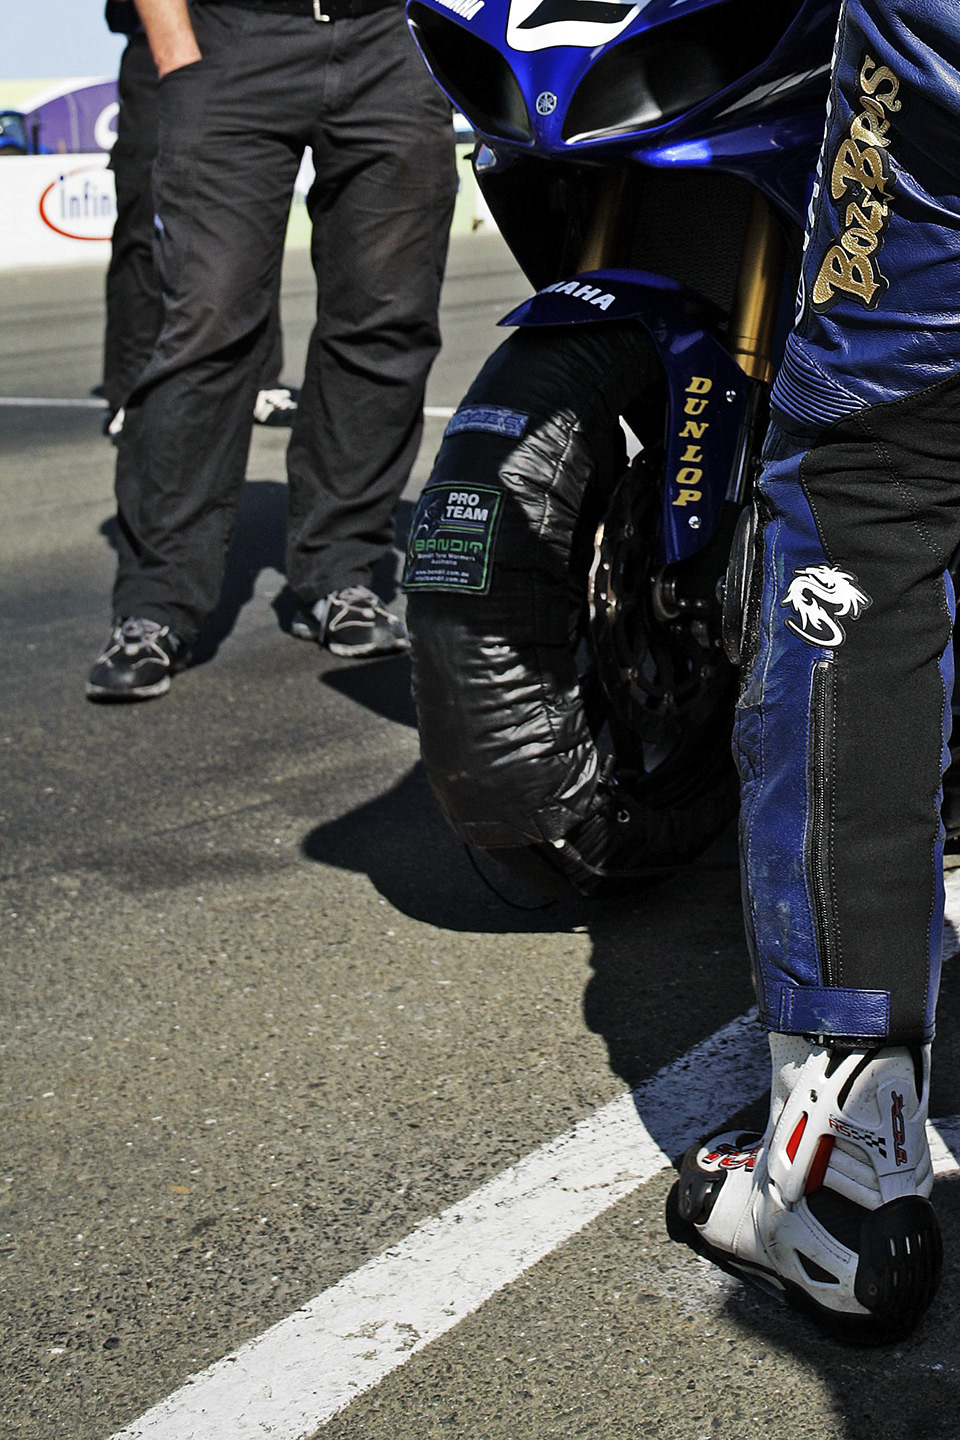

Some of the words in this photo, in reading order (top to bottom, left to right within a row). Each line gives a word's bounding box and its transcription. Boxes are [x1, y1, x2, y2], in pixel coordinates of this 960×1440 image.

[671, 376, 713, 507] DUNLOP
[447, 492, 480, 507] PRO
[446, 506, 489, 522] TEAM
[415, 538, 483, 554] BANDIT
[828, 1118, 851, 1137] RS
[891, 1091, 907, 1167] TCX
